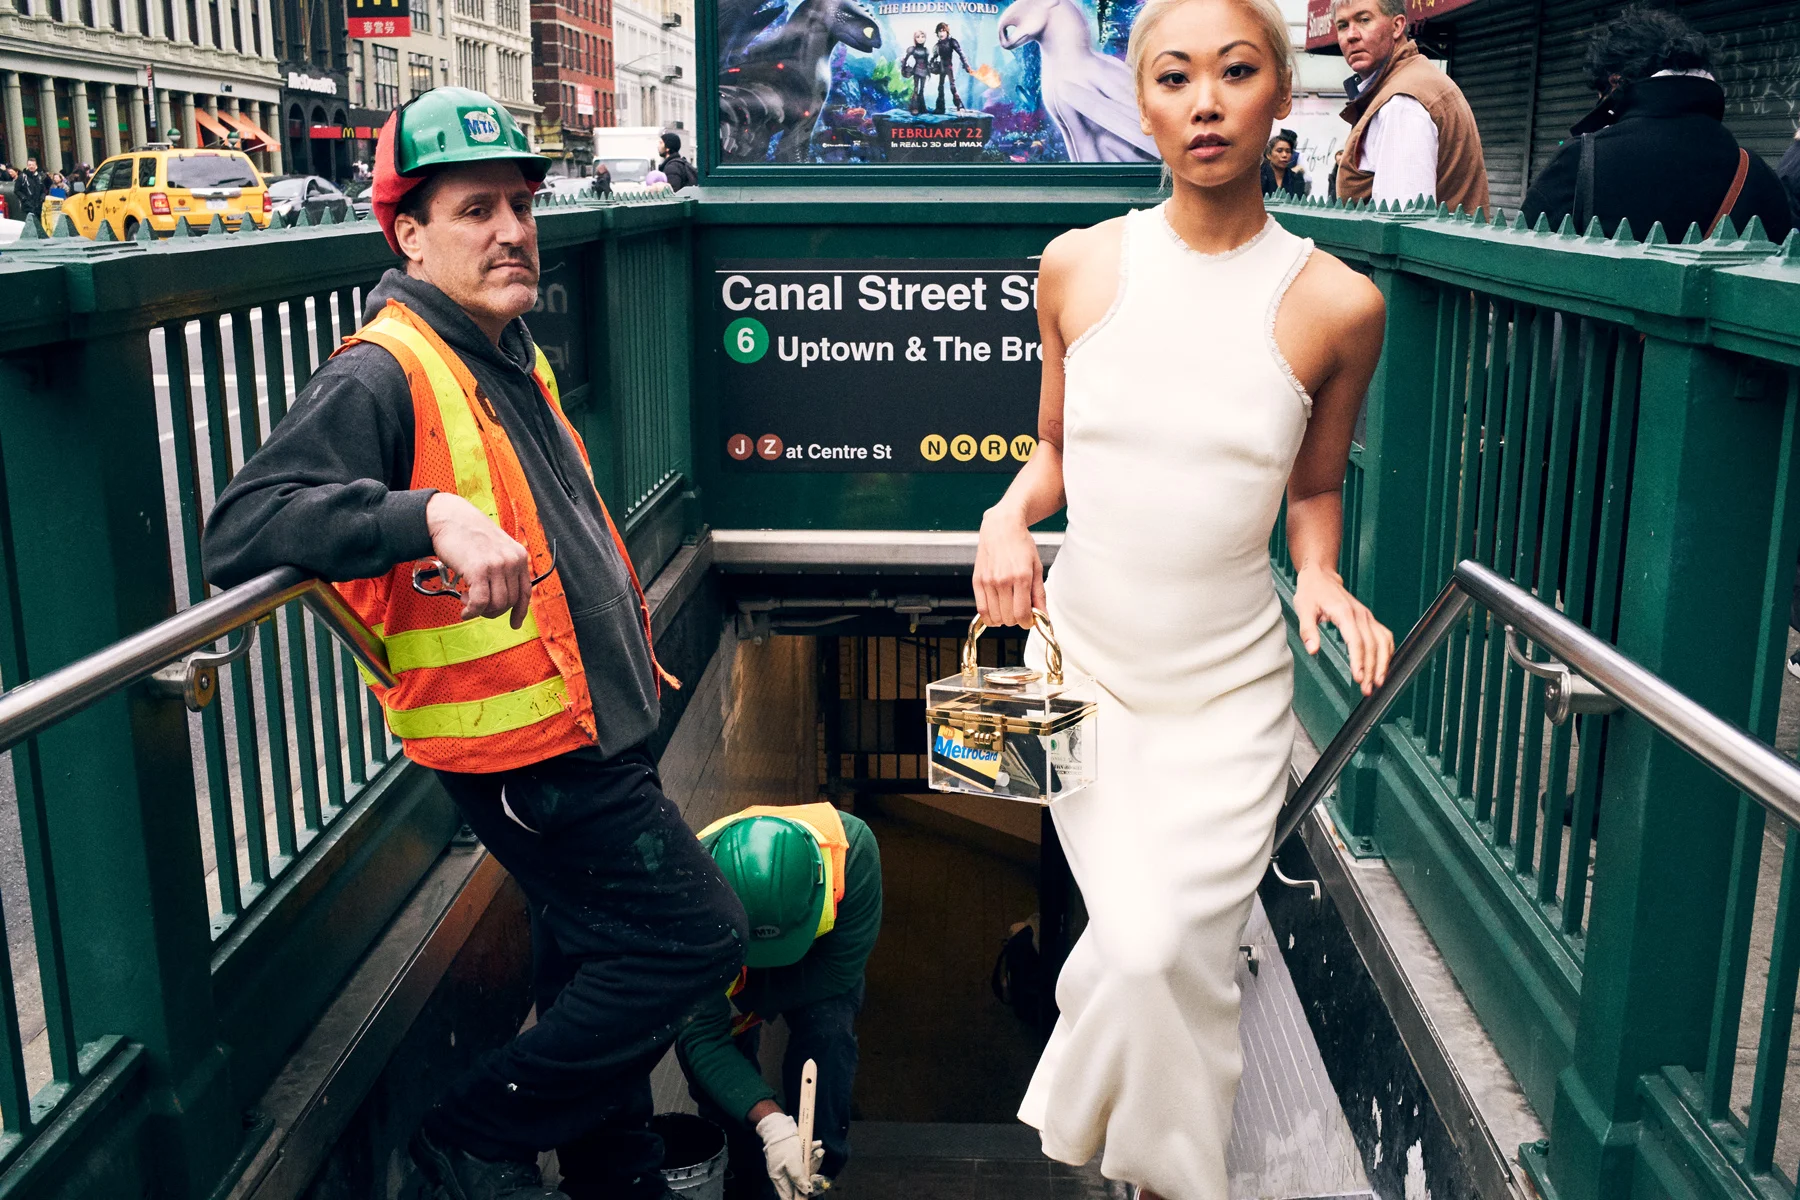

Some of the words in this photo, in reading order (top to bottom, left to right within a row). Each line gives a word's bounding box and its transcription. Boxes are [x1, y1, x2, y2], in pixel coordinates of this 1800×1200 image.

[879, 3, 899, 14] THE
[902, 2, 954, 13] HIDDEN
[956, 2, 999, 14] WORLD
[464, 119, 495, 135] MTA
[891, 128, 961, 138] FEBRUARY
[967, 128, 983, 138] 22
[722, 275, 843, 311] Canal
[858, 274, 988, 311] Street
[736, 327, 756, 353] 6
[778, 336, 895, 368] Uptown
[905, 335, 928, 362] &
[933, 336, 992, 362] The
[734, 439, 746, 455] J
[763, 440, 777, 455] Z
[785, 445, 803, 459] at
[808, 444, 868, 460] Centre
[872, 444, 892, 460] St
[928, 441, 941, 455] N
[957, 441, 971, 456] Q
[988, 441, 1001, 455] R
[1015, 441, 1033, 456] W
[934, 735, 999, 761] MetroCard
[753, 928, 776, 937] MTA
